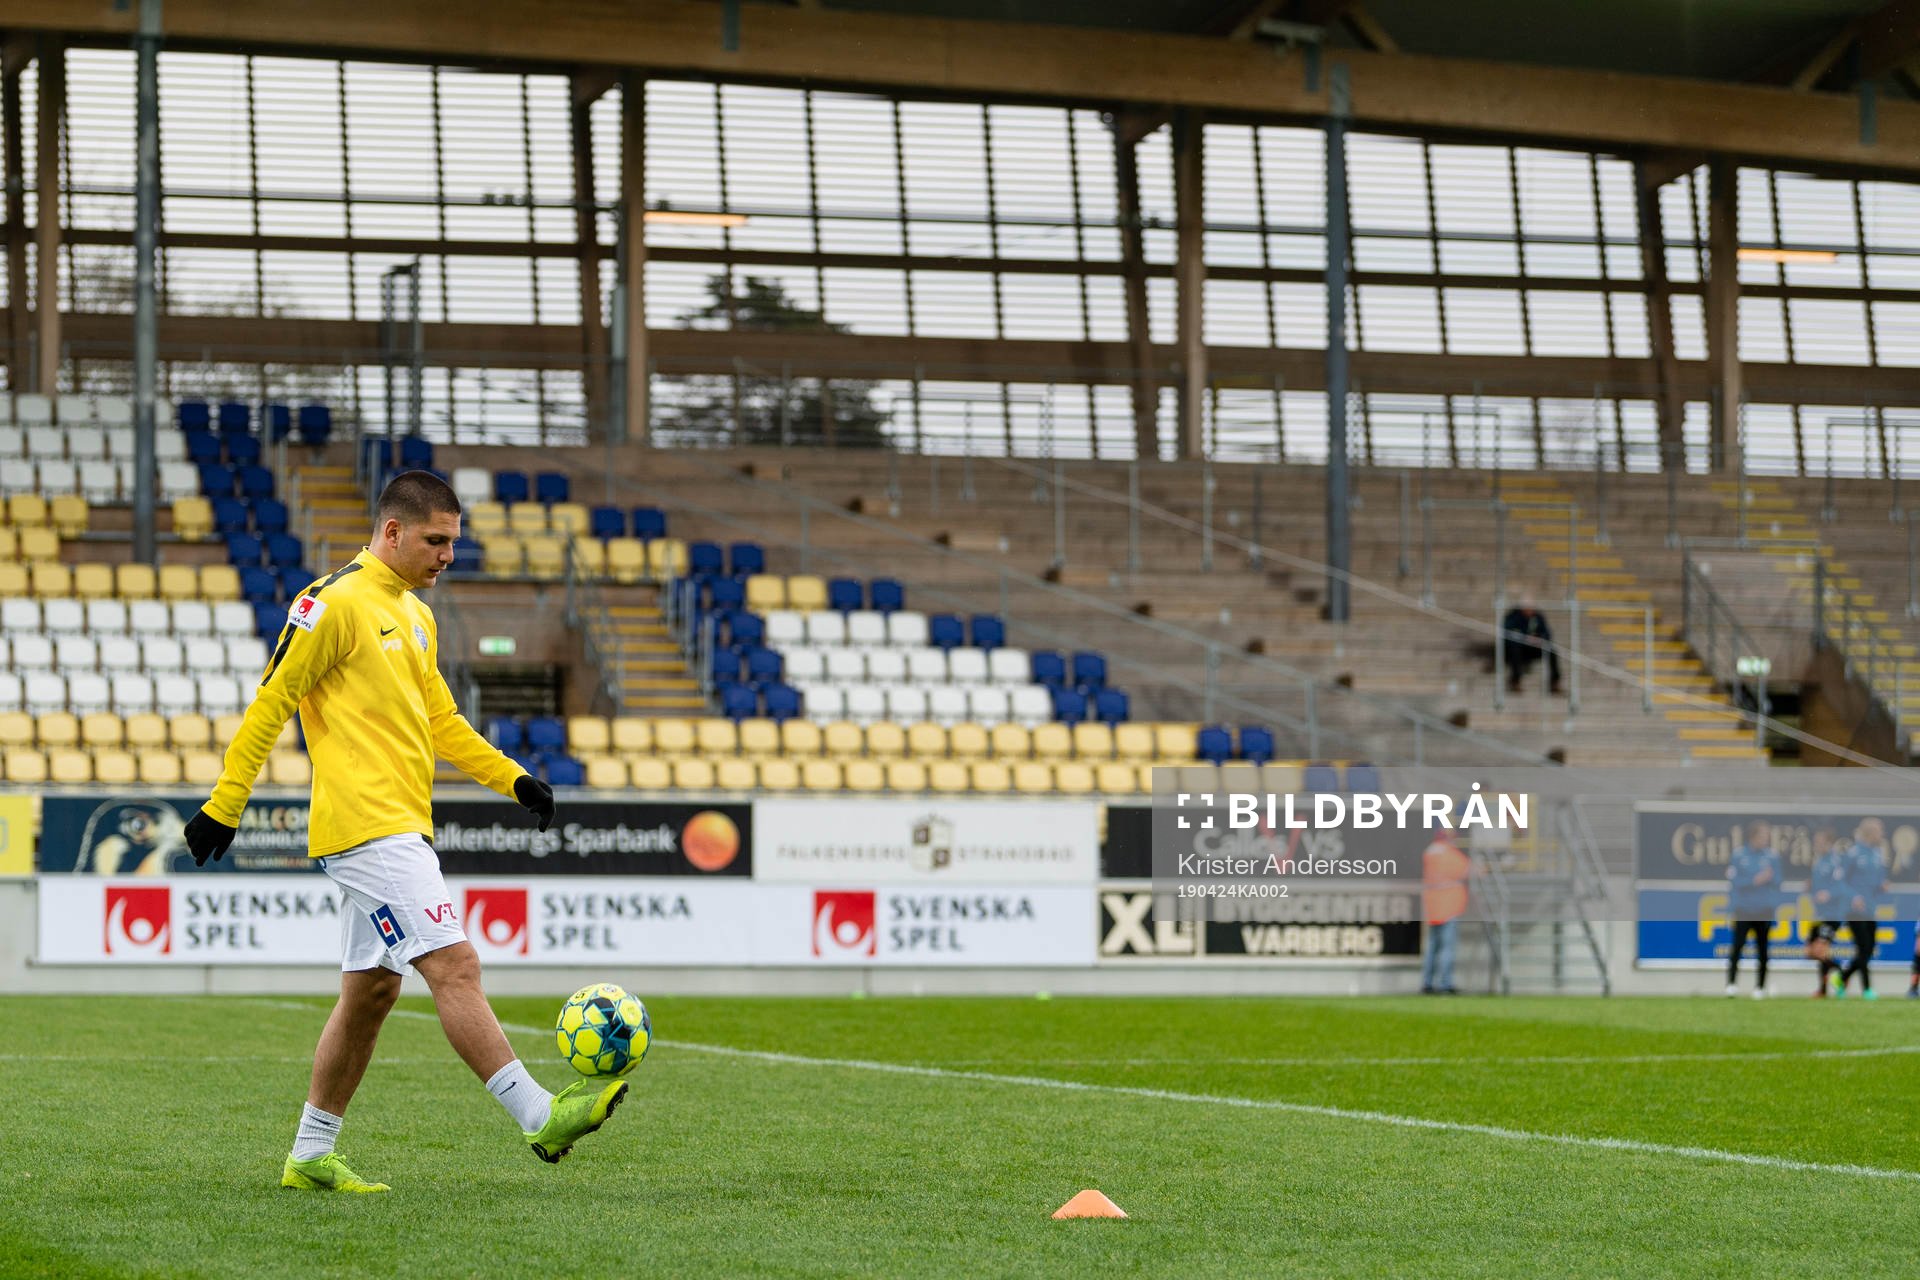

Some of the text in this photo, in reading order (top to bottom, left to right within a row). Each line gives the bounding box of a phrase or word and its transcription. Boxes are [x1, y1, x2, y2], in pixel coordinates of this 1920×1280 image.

[239, 806, 311, 831] ALCO
[432, 822, 678, 858] alkenbergs Sparbank
[186, 891, 339, 918] SVENSKA
[542, 893, 692, 919] SVENSKA
[888, 895, 1036, 921] SVENSKA
[1101, 893, 1194, 953] XL
[186, 925, 265, 949] SPEL
[542, 925, 619, 950] SPEL
[889, 926, 965, 951] SPEL
[1241, 924, 1384, 954] VARBERG
